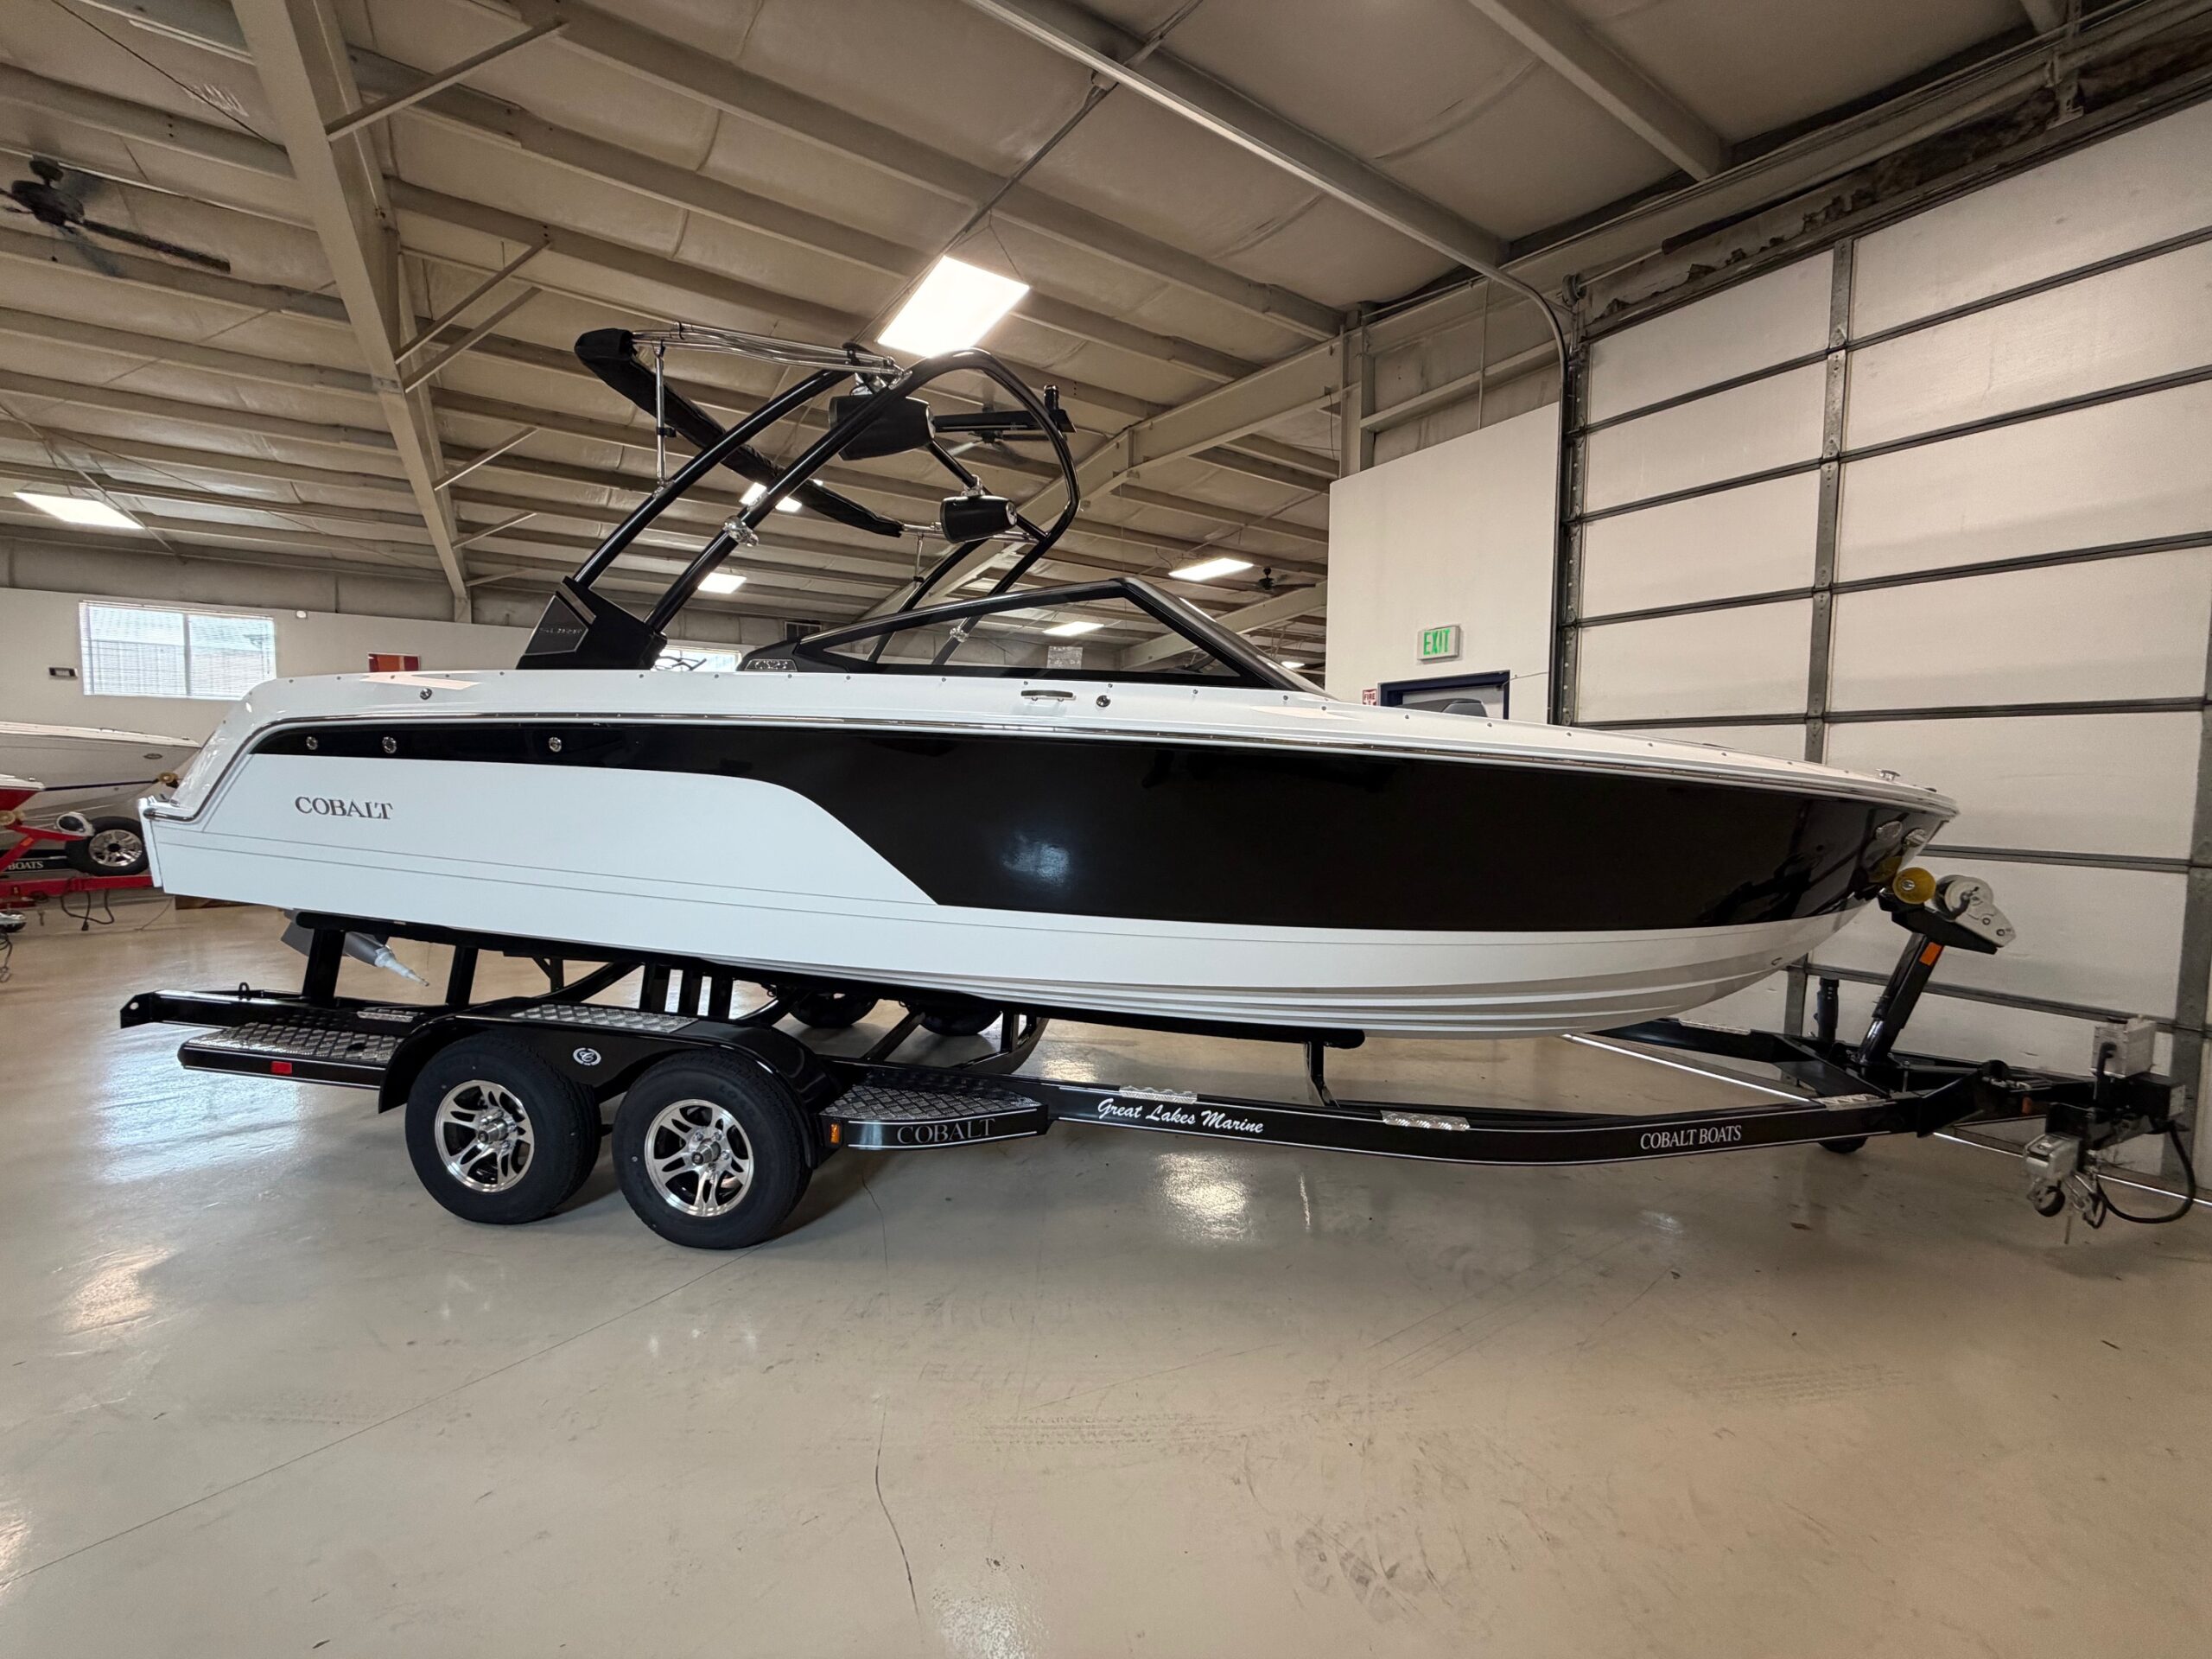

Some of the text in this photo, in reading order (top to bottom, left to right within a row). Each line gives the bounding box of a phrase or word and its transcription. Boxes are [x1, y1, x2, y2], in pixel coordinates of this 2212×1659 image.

[1423, 629, 1451, 655] EXIT
[1363, 692, 1376, 701] FIRE
[295, 796, 393, 820] COBALT
[1097, 1097, 1264, 1134] Great Lakes Marine
[897, 1117, 996, 1145] COBALT
[1640, 1125, 1742, 1150] COBALT BOATS
